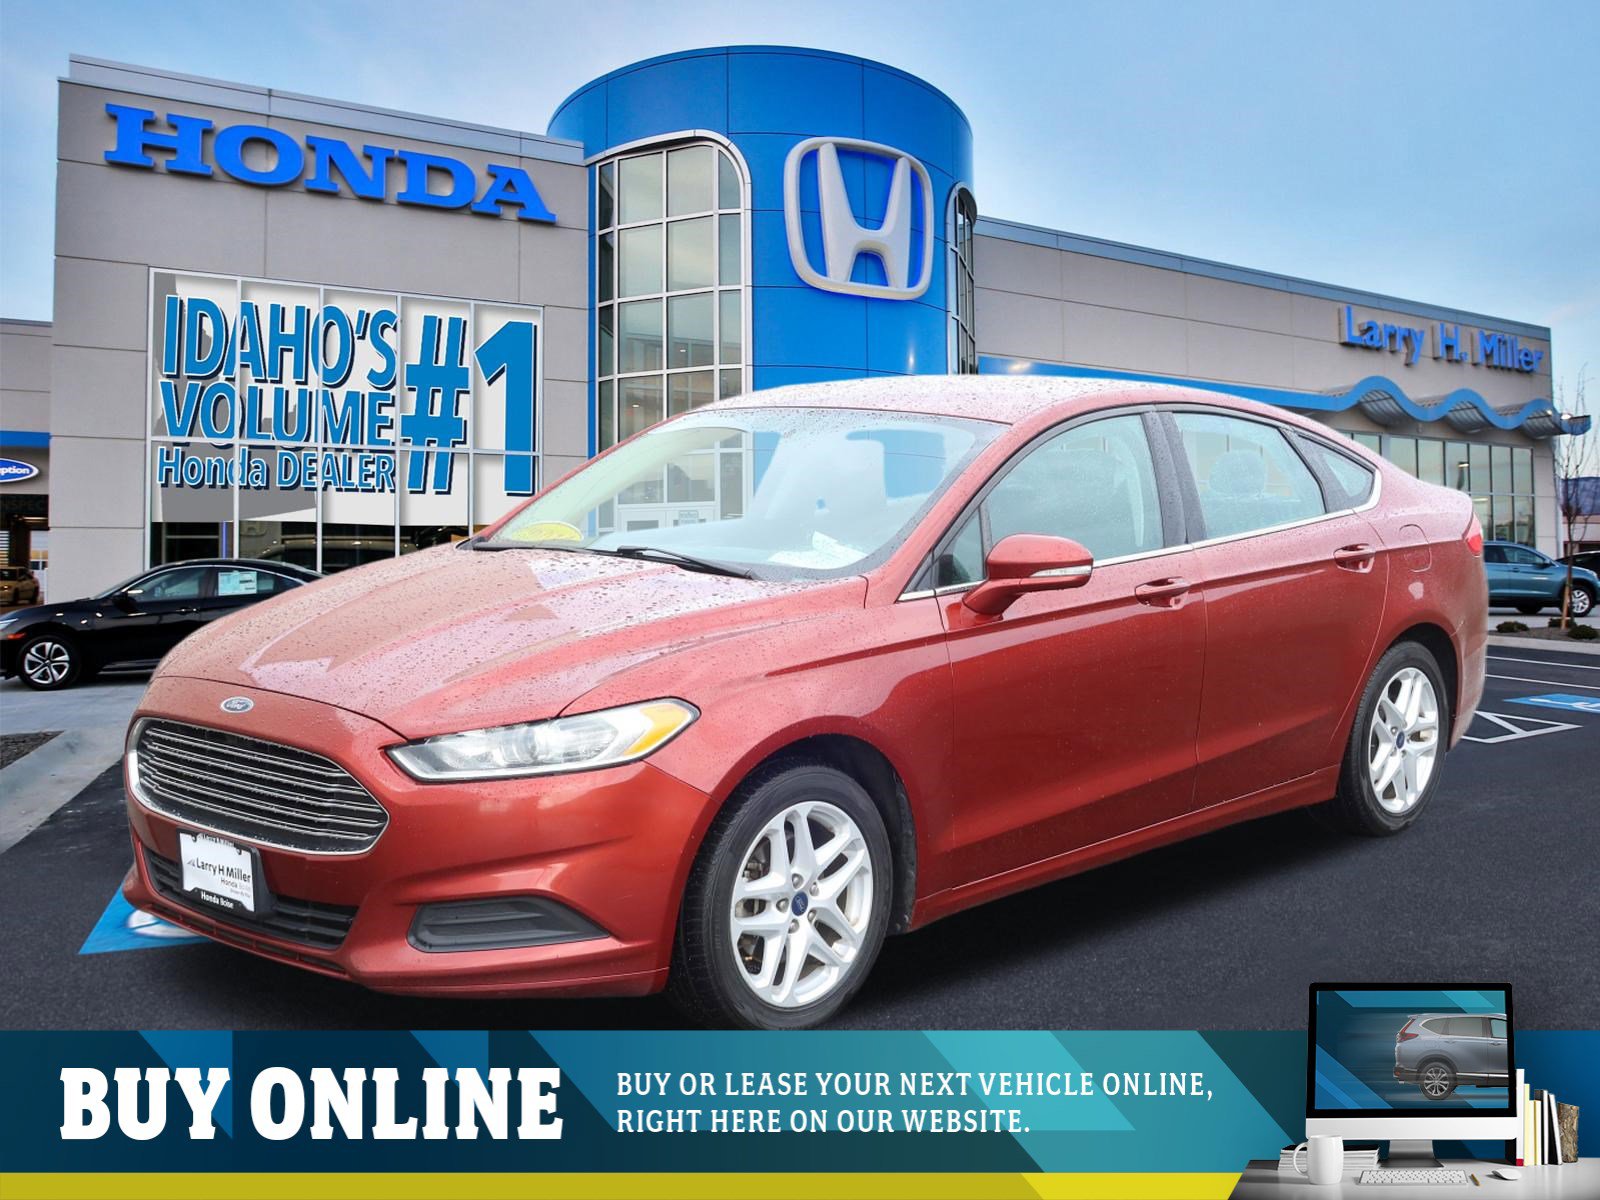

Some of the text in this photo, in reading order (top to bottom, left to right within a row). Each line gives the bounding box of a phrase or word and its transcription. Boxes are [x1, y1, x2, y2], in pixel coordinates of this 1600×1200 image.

[105, 103, 557, 224] HONDA
[162, 294, 399, 391] IDAHO'S
[1341, 305, 1545, 374] Larry H. Miller
[158, 379, 398, 449] VOLUME
[400, 314, 538, 497] #1
[0, 465, 30, 476] ption
[157, 446, 397, 493] Honda DEALER
[195, 857, 251, 883] Larry H Miller
[200, 891, 219, 905] Honda
